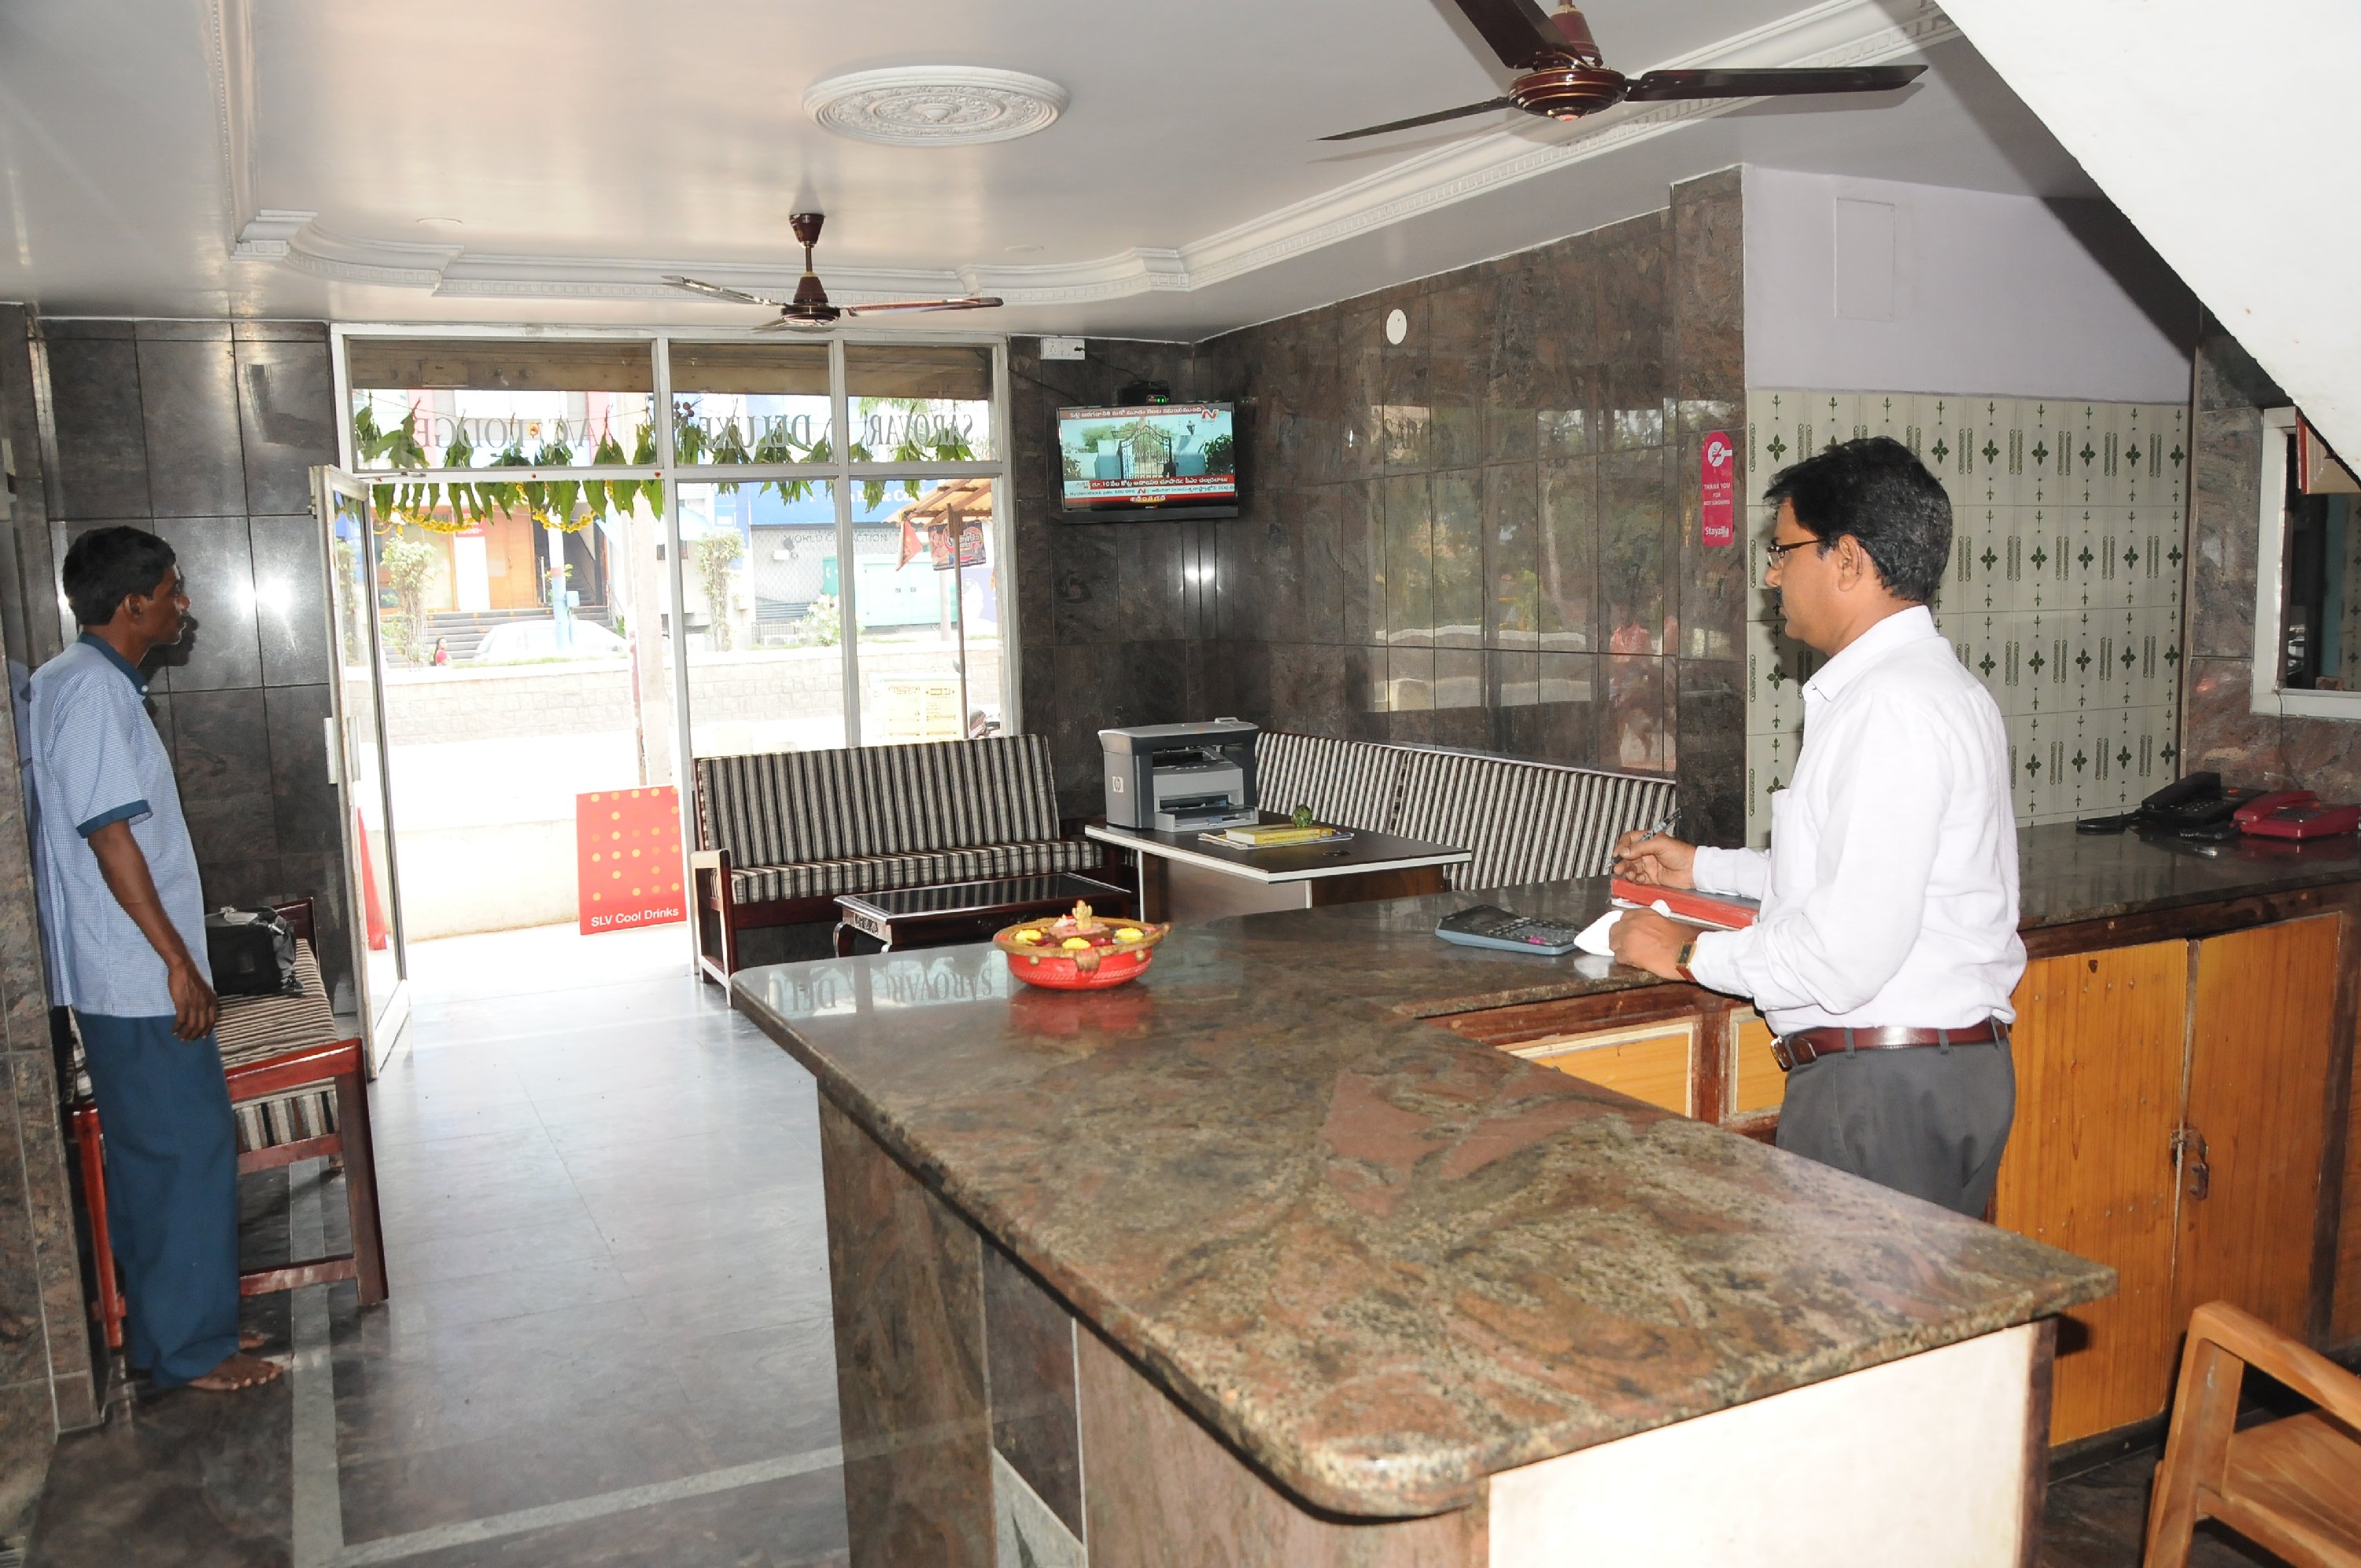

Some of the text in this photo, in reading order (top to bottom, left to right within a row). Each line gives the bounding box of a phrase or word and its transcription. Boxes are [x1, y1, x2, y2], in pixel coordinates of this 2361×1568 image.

[591, 907, 680, 927] SLV Cool Drinks
